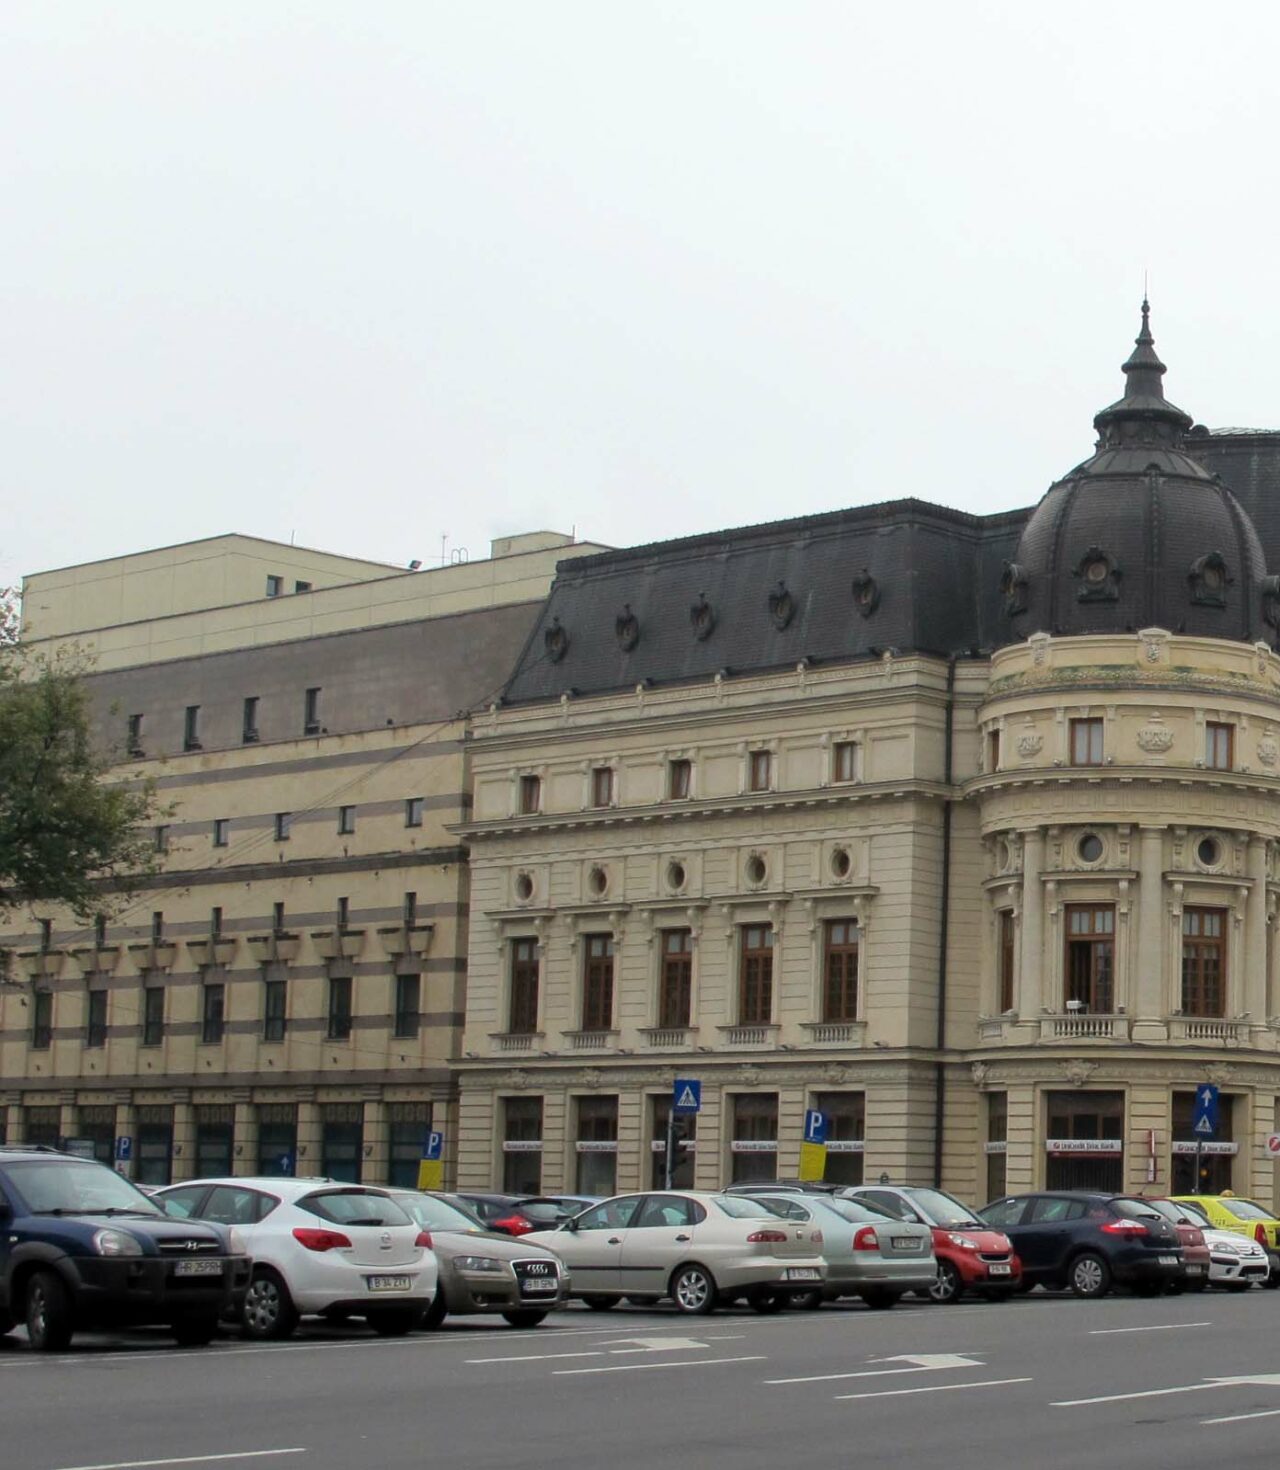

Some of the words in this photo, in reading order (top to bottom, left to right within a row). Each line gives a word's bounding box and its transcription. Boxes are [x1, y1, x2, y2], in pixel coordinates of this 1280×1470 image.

[810, 1111, 823, 1137] P
[120, 1137, 129, 1157] P
[427, 1133, 439, 1155] P
